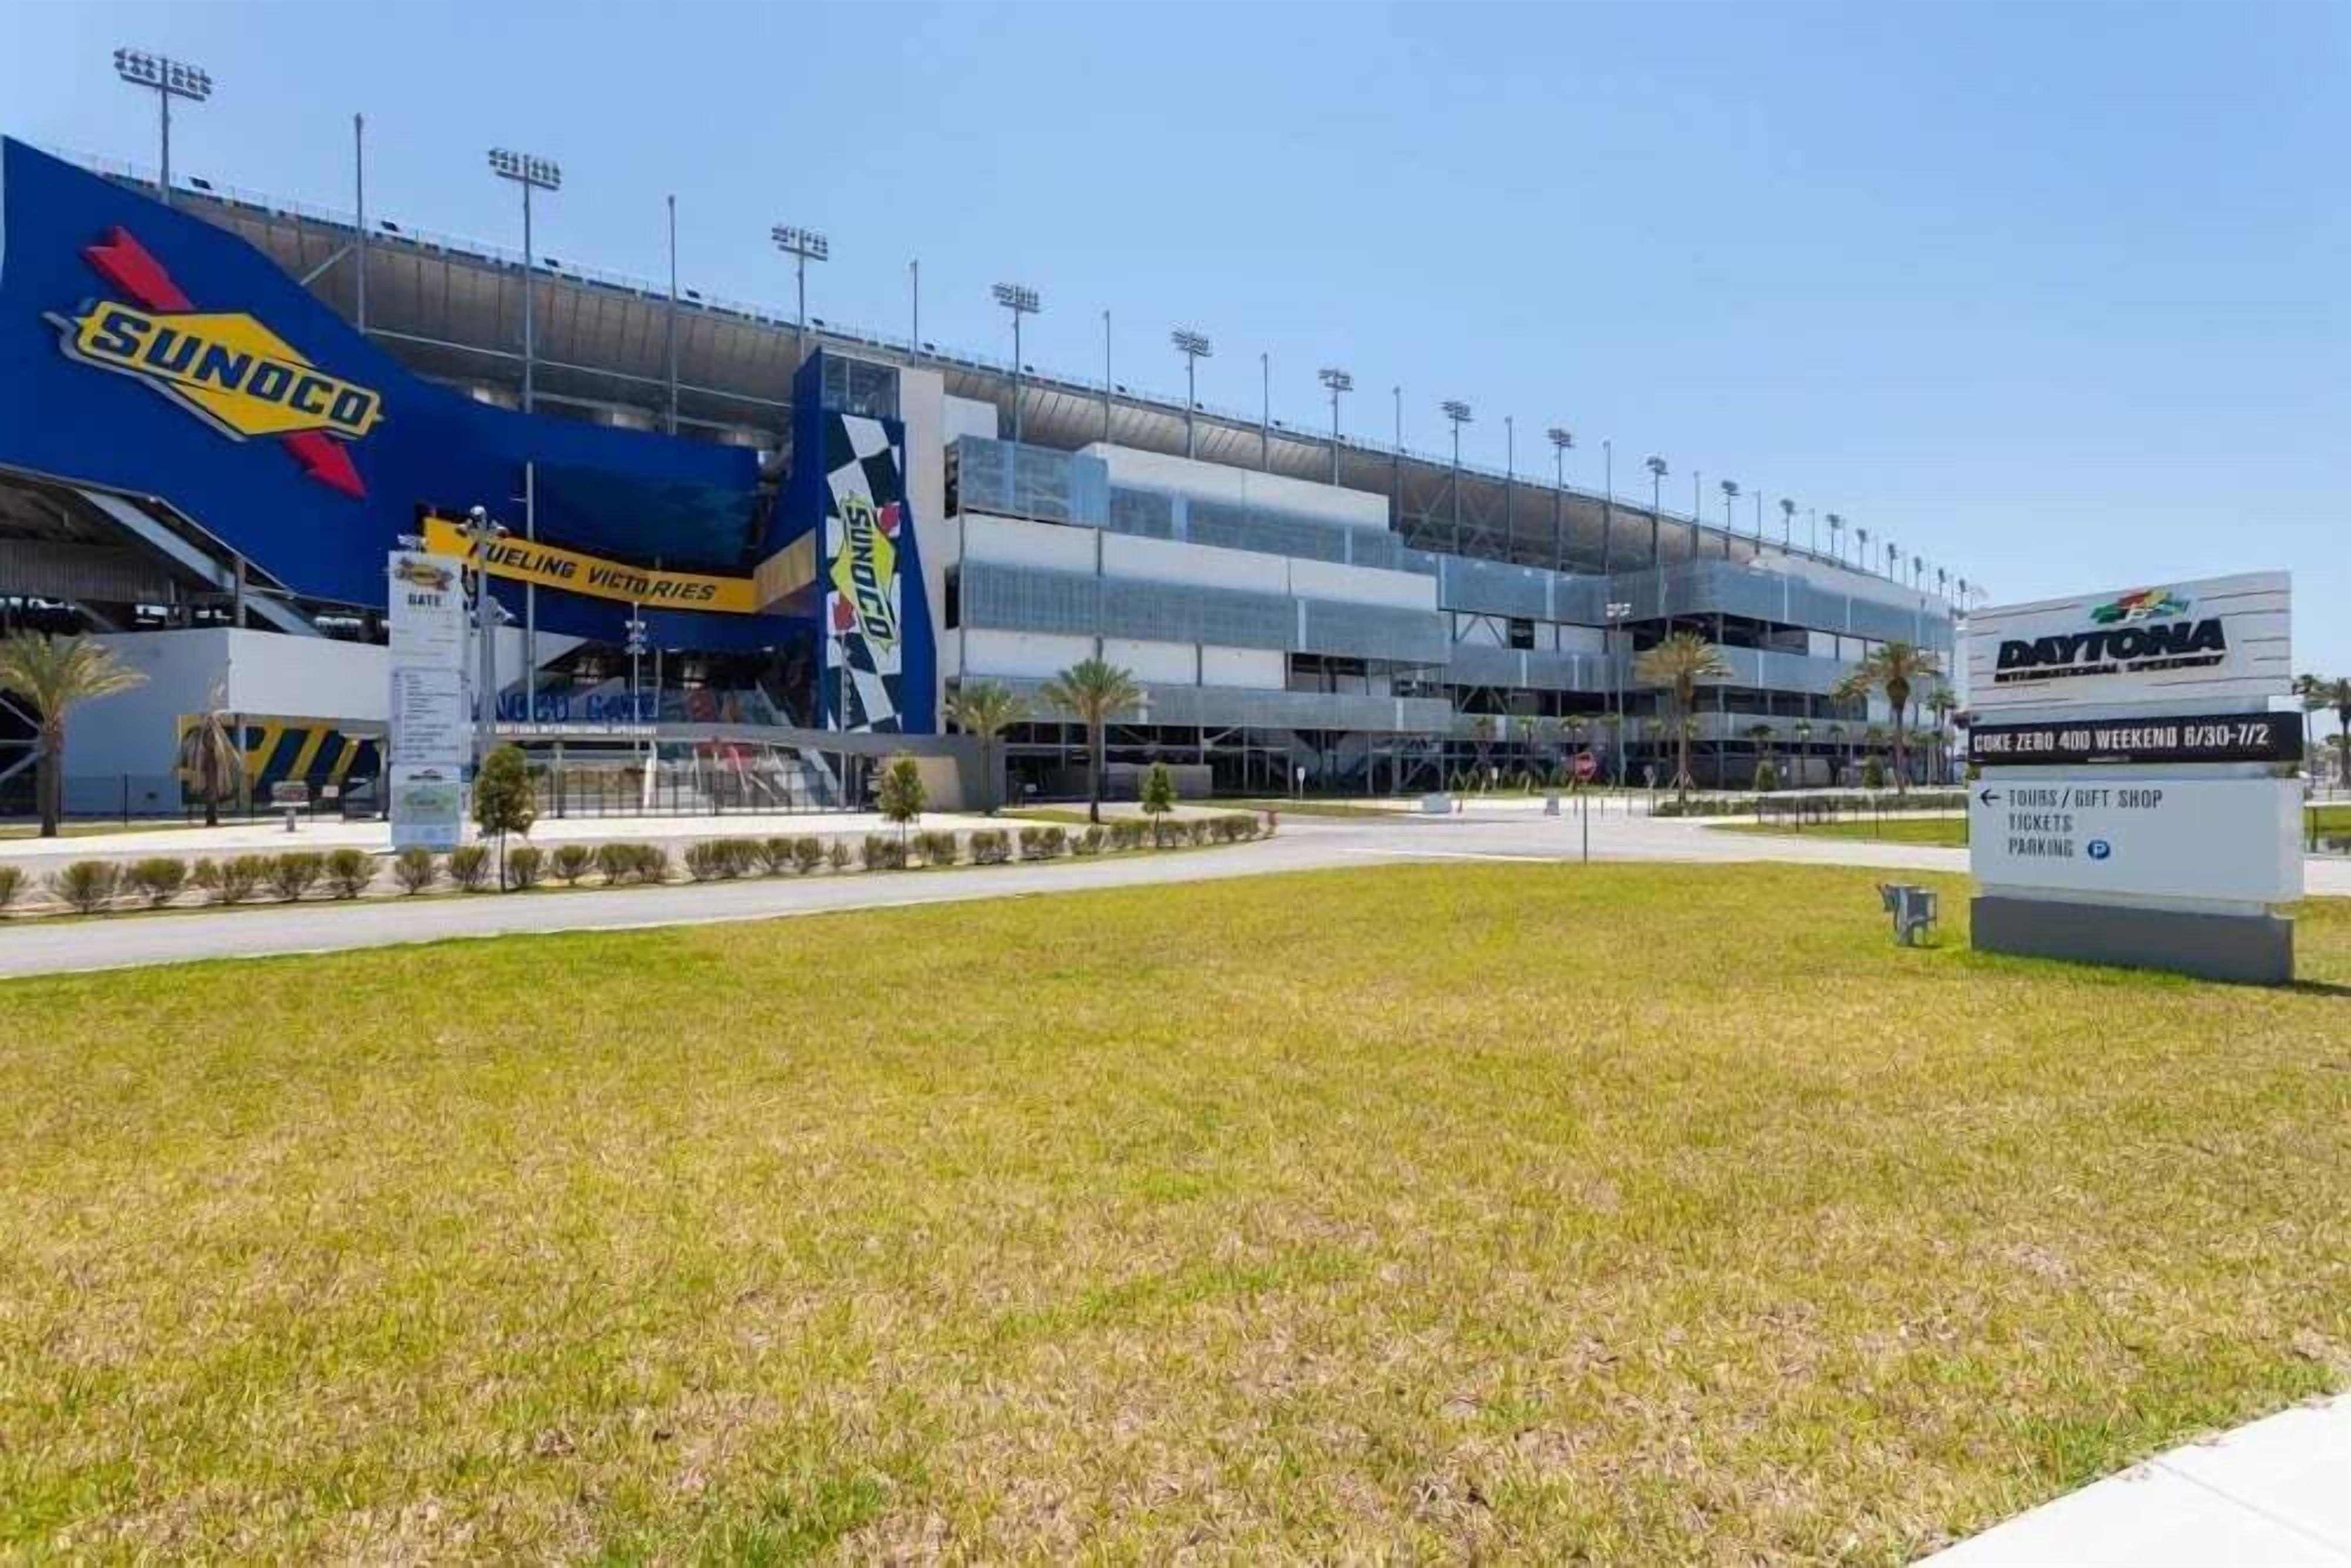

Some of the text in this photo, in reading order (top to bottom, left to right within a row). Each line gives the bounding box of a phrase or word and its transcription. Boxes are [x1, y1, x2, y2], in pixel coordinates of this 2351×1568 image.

[92, 312, 371, 425] SUNOCO
[587, 566, 716, 601] VICTORIES
[846, 505, 893, 639] SUNOCO
[1996, 618, 2226, 669] DAYTONA
[1974, 733, 2012, 752] COKE
[2017, 731, 2054, 752] ZERO
[2059, 731, 2091, 751] 400
[2095, 726, 2177, 751] WEEKEND
[2118, 789, 2164, 809] SHOP
[2008, 813, 2074, 833] TICKETS
[2008, 837, 2074, 858] PARKING
